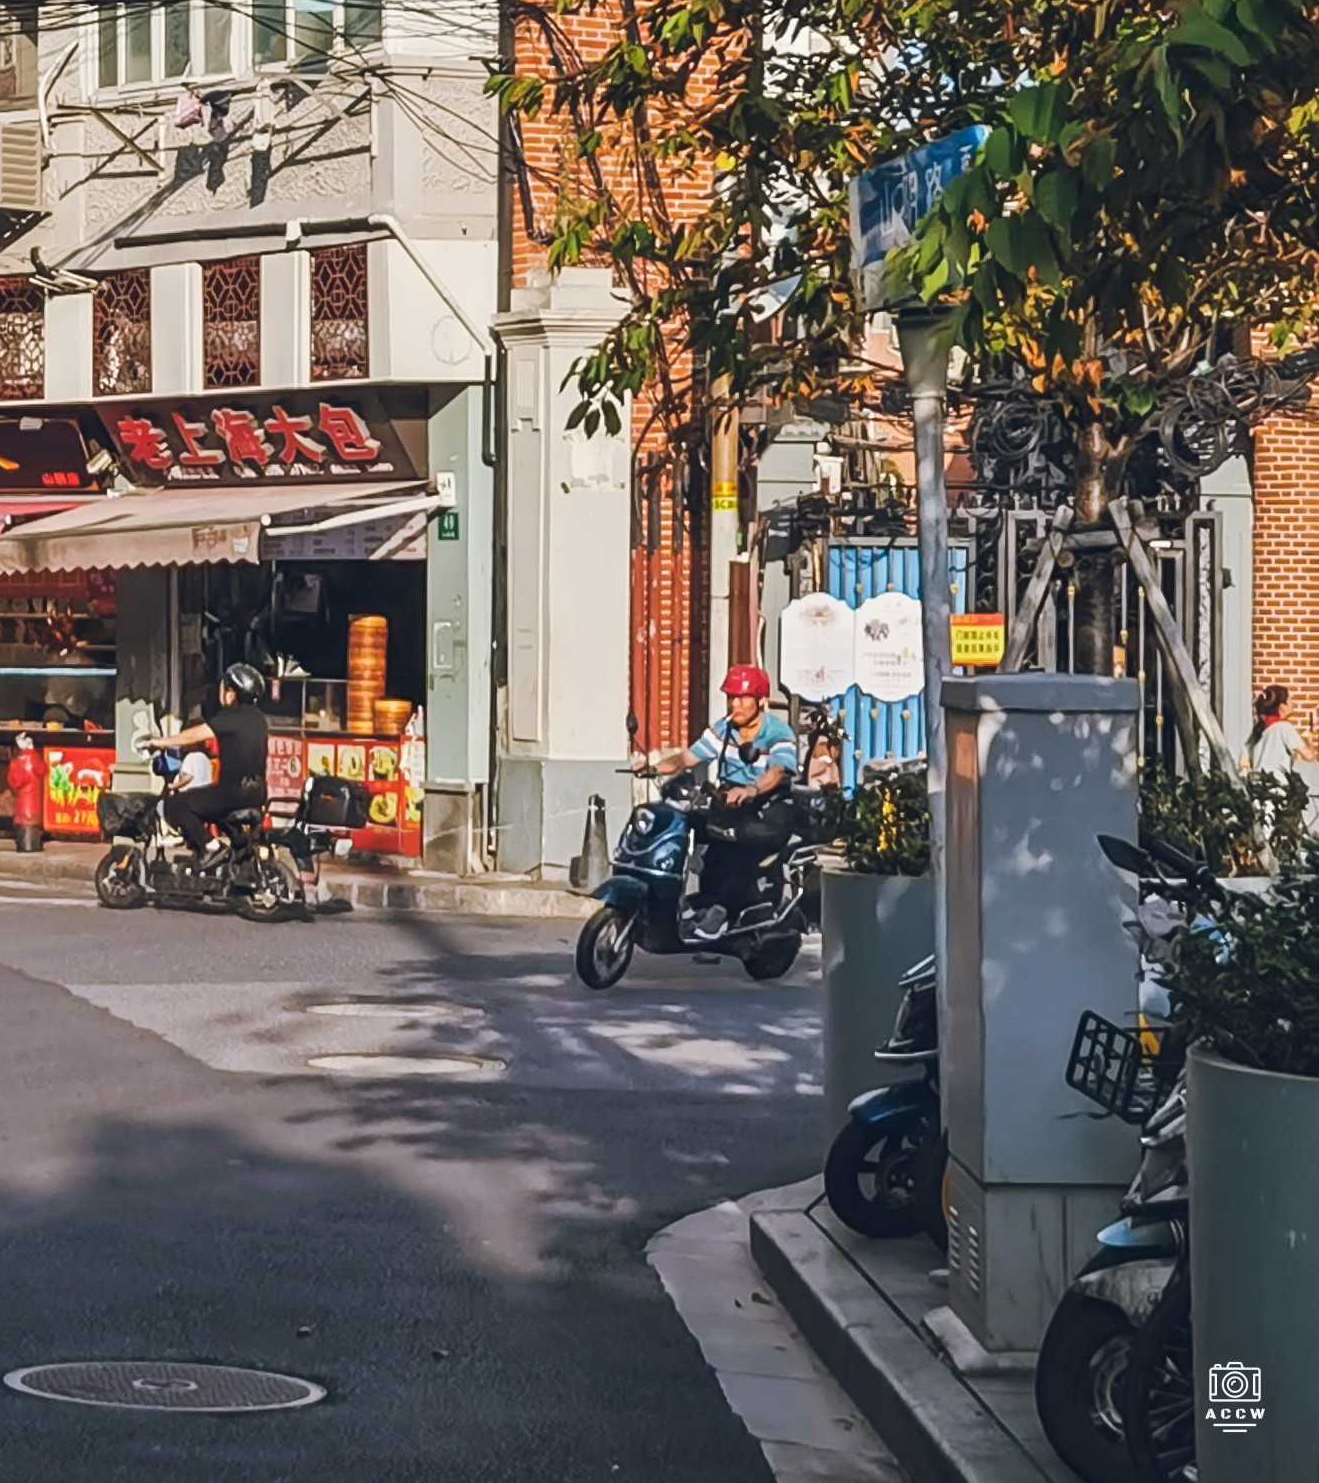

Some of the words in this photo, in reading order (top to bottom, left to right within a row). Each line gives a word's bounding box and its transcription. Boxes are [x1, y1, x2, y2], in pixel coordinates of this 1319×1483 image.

[117, 403, 381, 469] 老上海大包
